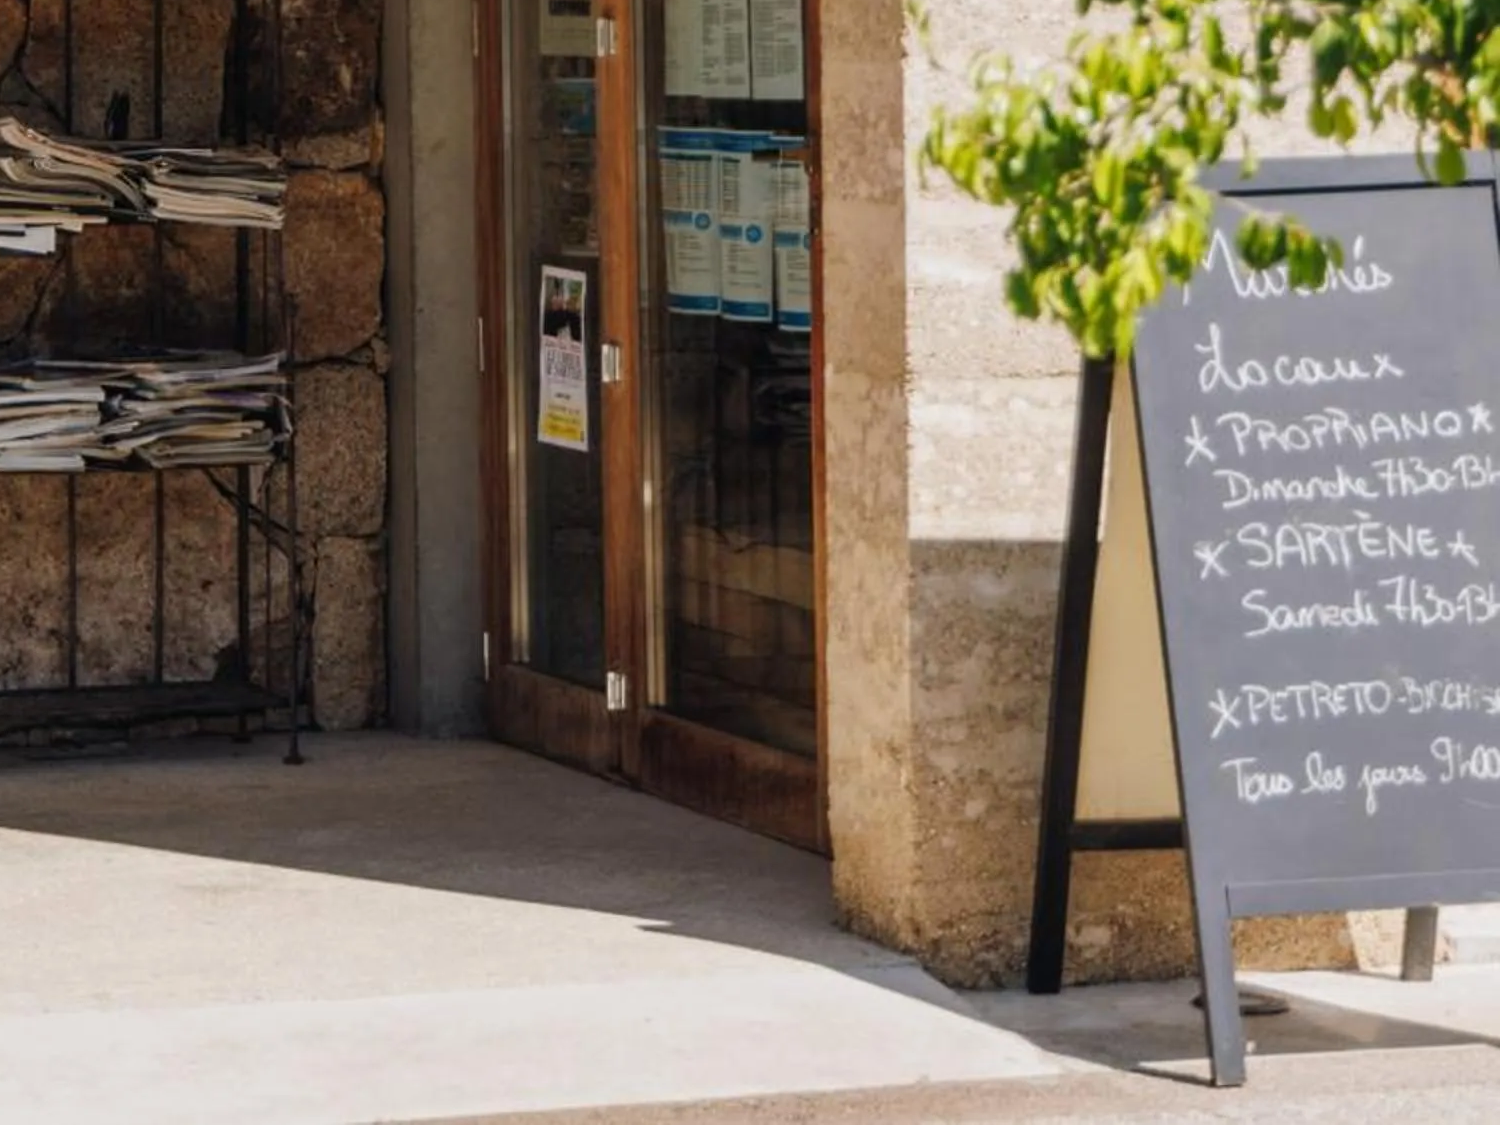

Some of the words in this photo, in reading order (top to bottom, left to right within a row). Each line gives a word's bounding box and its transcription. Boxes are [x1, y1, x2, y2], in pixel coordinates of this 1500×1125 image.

[1236, 509, 1441, 574] SARTÈNE
[1240, 588, 1380, 638] Samedi
[1219, 756, 1295, 804] Tous
[1300, 751, 1347, 794] les
